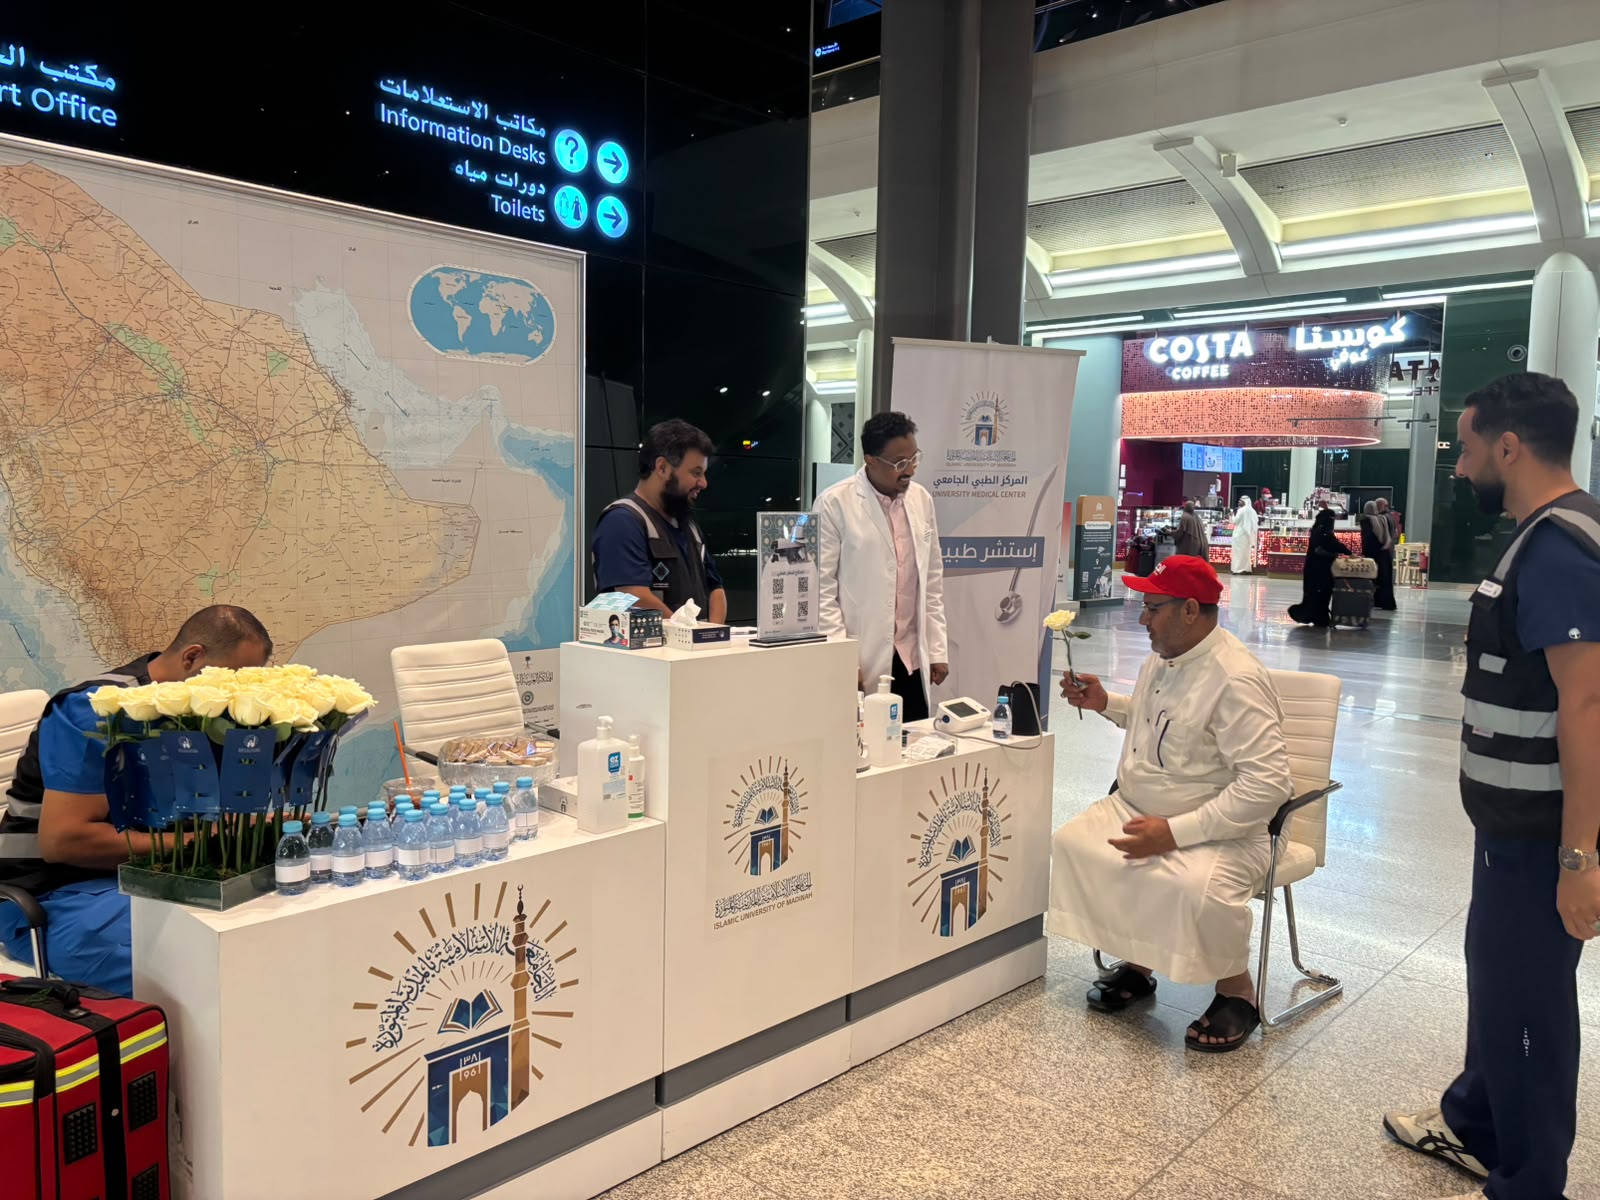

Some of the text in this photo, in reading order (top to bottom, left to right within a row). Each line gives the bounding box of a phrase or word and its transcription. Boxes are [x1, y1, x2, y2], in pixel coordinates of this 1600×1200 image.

[40, 61, 116, 91] مكتب
[31, 87, 118, 127] Office
[380, 79, 546, 138] مكاتب الاستعلامات
[380, 103, 546, 165] Information Desks
[455, 160, 546, 196] دورات مياه
[491, 194, 546, 222] Toilets
[1149, 331, 1254, 363] COSTA
[1295, 316, 1407, 351] كوستا
[1171, 364, 1230, 380] COFFEE
[1330, 349, 1369, 371] كوفي
[932, 490, 1026, 498] UNIVERSITY MEDICAL CENTER
[933, 475, 1028, 489] المركز الطبي الجامعي
[979, 540, 1037, 562] إستشر
[713, 892, 813, 930] ISLAMIC UNIVERSITY OF MADINAH
